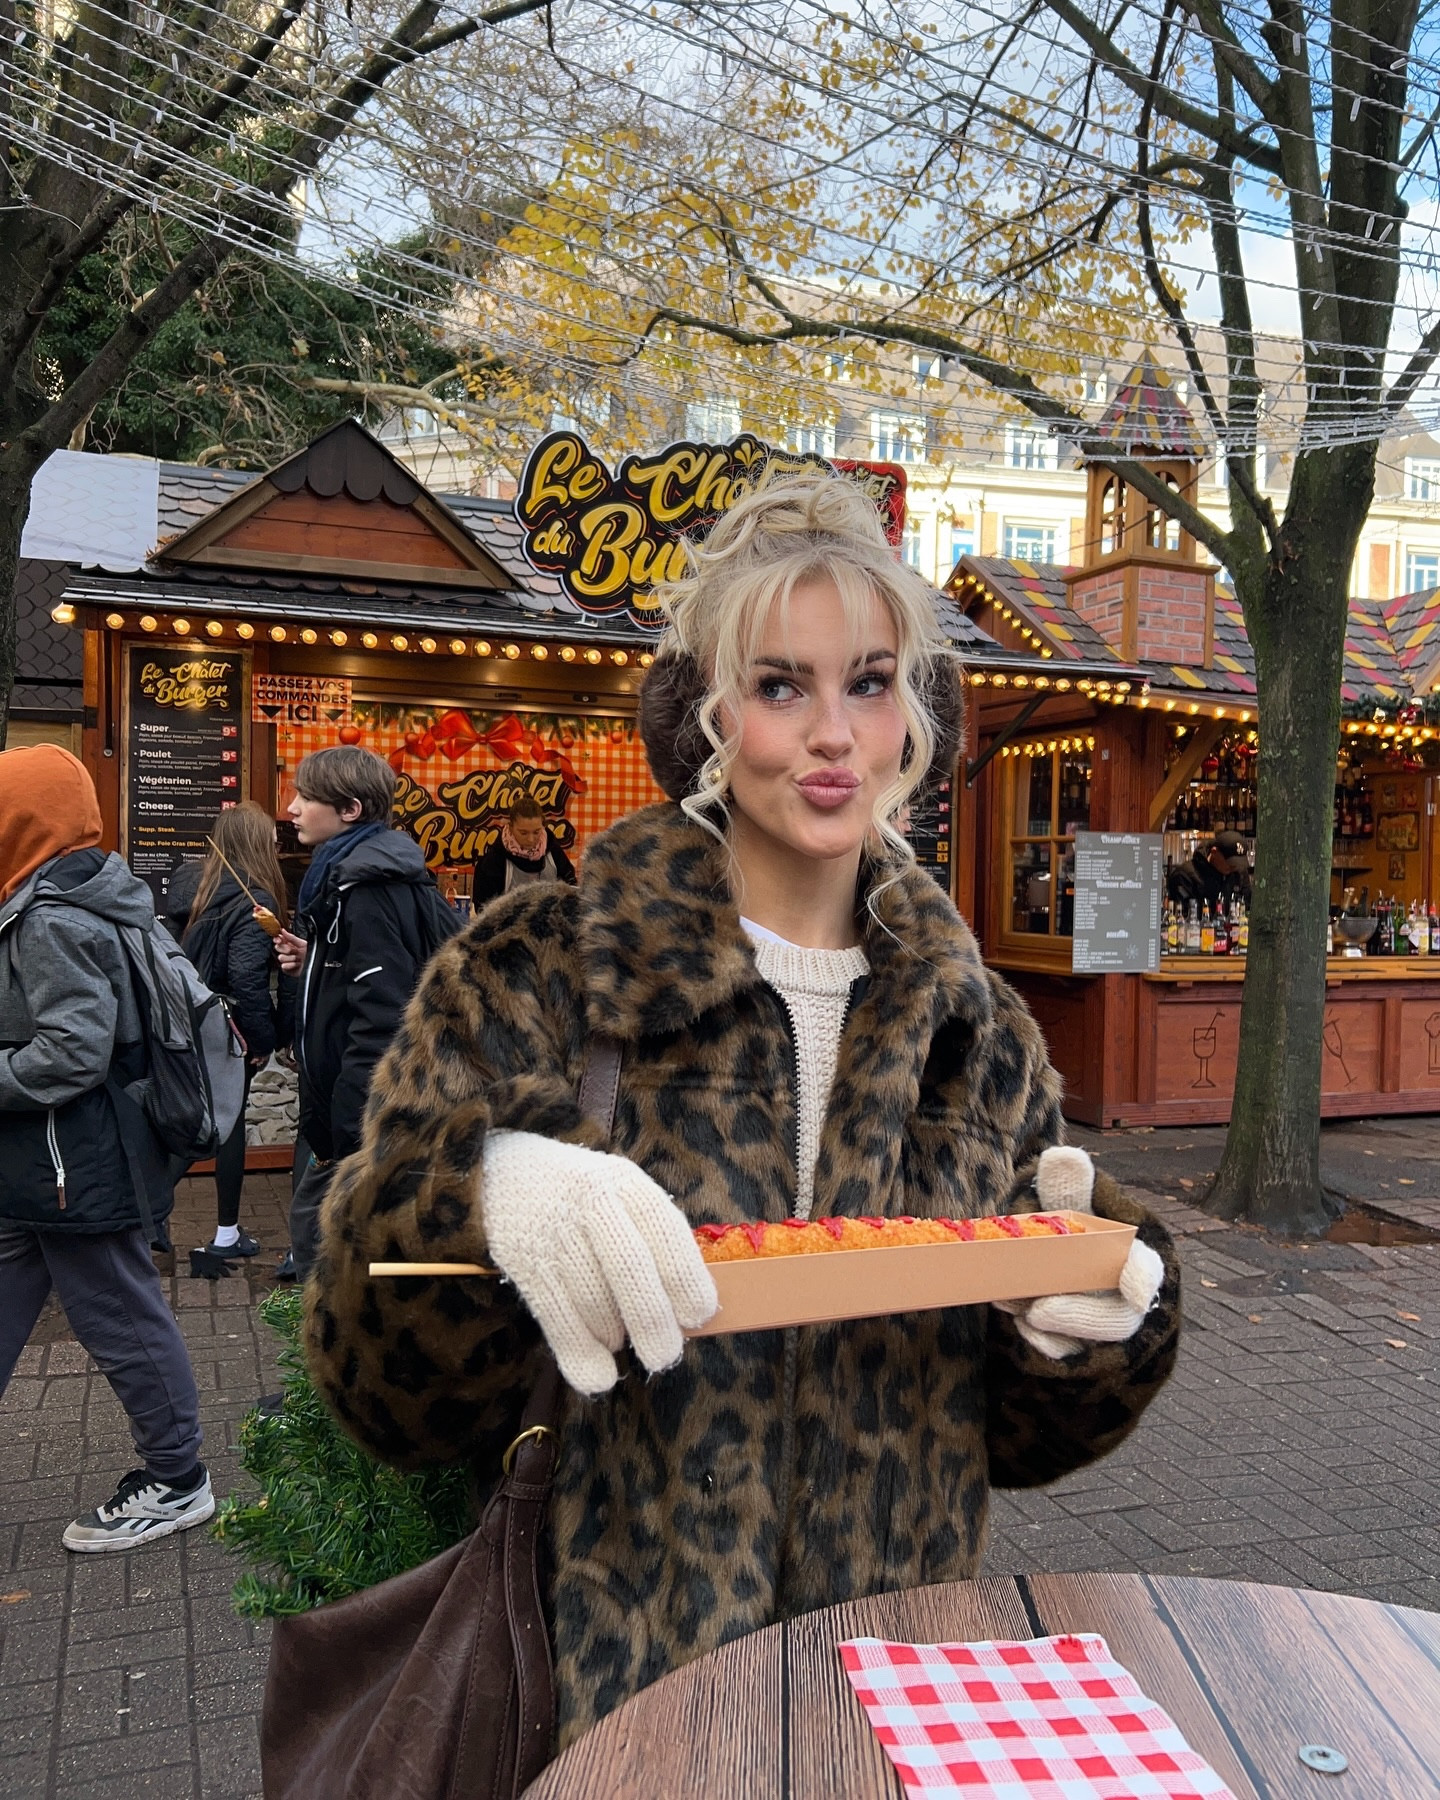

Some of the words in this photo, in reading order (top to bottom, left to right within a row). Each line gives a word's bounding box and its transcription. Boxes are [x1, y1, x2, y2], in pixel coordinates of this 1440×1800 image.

[526, 439, 606, 518] Le
[533, 519, 571, 555] du
[141, 663, 164, 684] Le
[259, 677, 312, 690] PASSEZ
[317, 680, 345, 691] VOS
[144, 684, 154, 693] du
[155, 678, 228, 707] Burger
[256, 690, 348, 704] COMMANDES
[288, 704, 317, 721] ICI
[140, 723, 169, 733] Super
[140, 749, 172, 758] Poulet
[139, 776, 192, 786] Végétarien
[138, 801, 174, 811] Cheese
